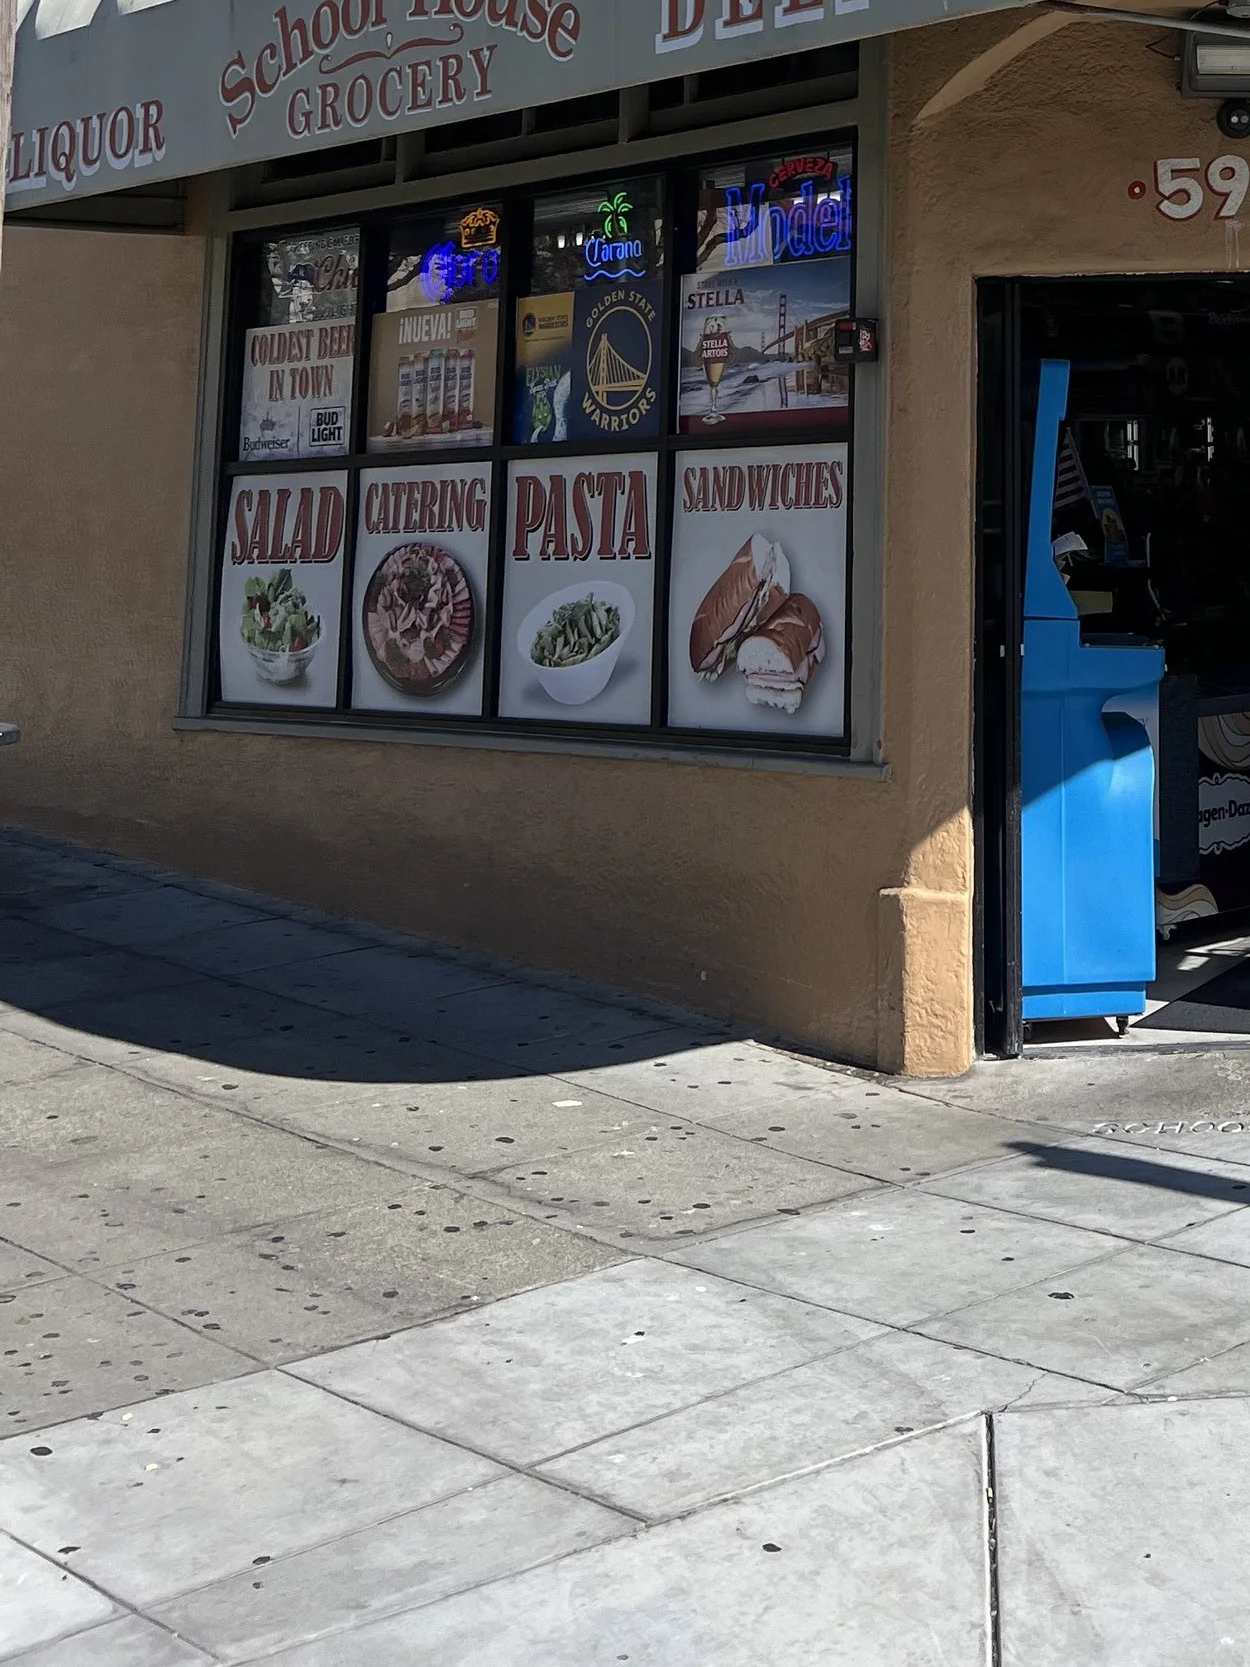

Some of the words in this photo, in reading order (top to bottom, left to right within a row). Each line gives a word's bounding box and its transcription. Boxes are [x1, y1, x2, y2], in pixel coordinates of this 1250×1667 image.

[286, 43, 498, 139] GROCERY
[6, 99, 167, 194] LIQUOR
[768, 156, 838, 190] CERVEZA
[586, 290, 625, 328] GOLDEN
[629, 291, 657, 322] STATE
[687, 289, 745, 310] STELLA
[398, 312, 452, 345] ¡NUEVA!
[702, 338, 728, 349] STELLA
[251, 329, 314, 367] COLDEST
[701, 348, 728, 359] ARTOIS
[268, 369, 285, 402] IN
[290, 364, 334, 401] TOWN
[316, 411, 339, 426] BUD
[582, 387, 657, 432] WARRIORS
[243, 436, 290, 451] Budweiser
[311, 426, 343, 443] LIGHT
[365, 477, 487, 534] CATERING
[683, 461, 844, 512] SANDWICHES
[231, 486, 345, 565] SALAD
[512, 470, 652, 561] PASTA
